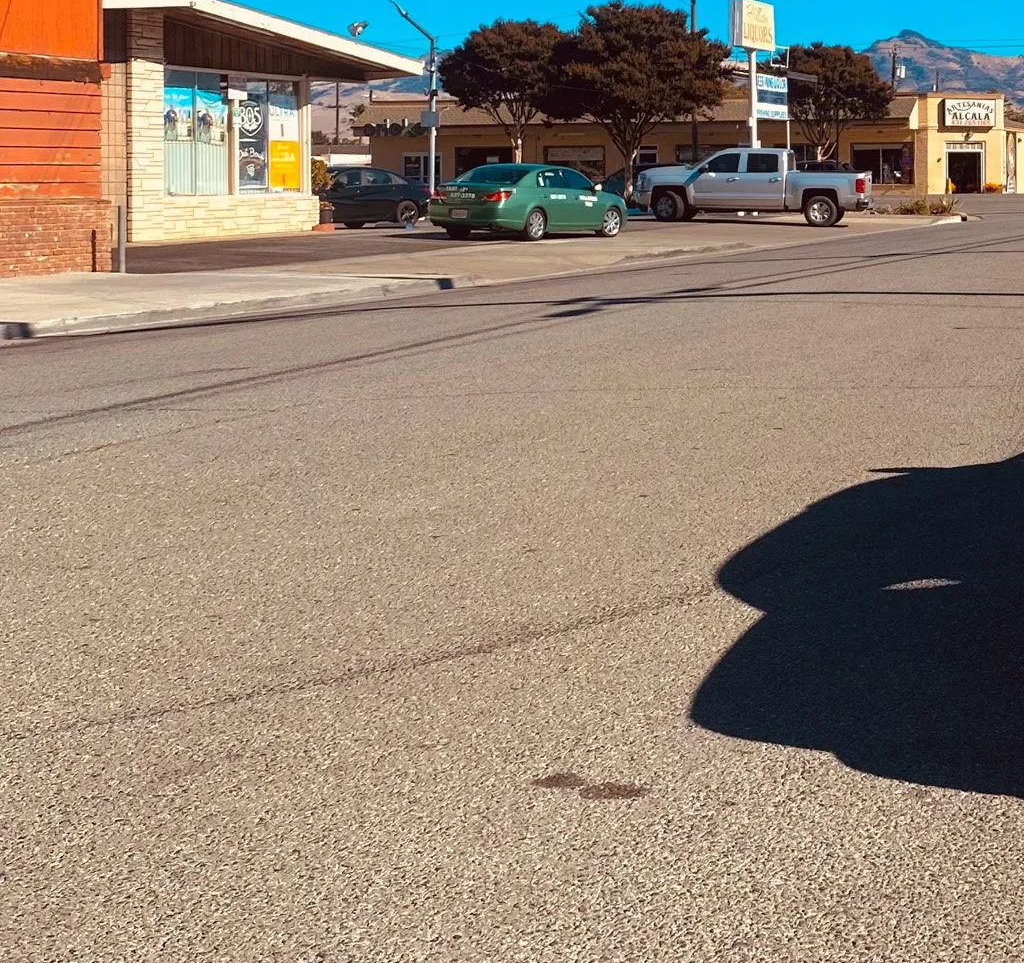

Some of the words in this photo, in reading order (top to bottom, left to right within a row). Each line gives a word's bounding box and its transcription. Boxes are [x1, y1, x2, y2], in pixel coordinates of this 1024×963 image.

[744, 22, 773, 44] LIQUORS
[946, 101, 994, 116] ARTESANIAS
[952, 112, 990, 121] ALCALA
